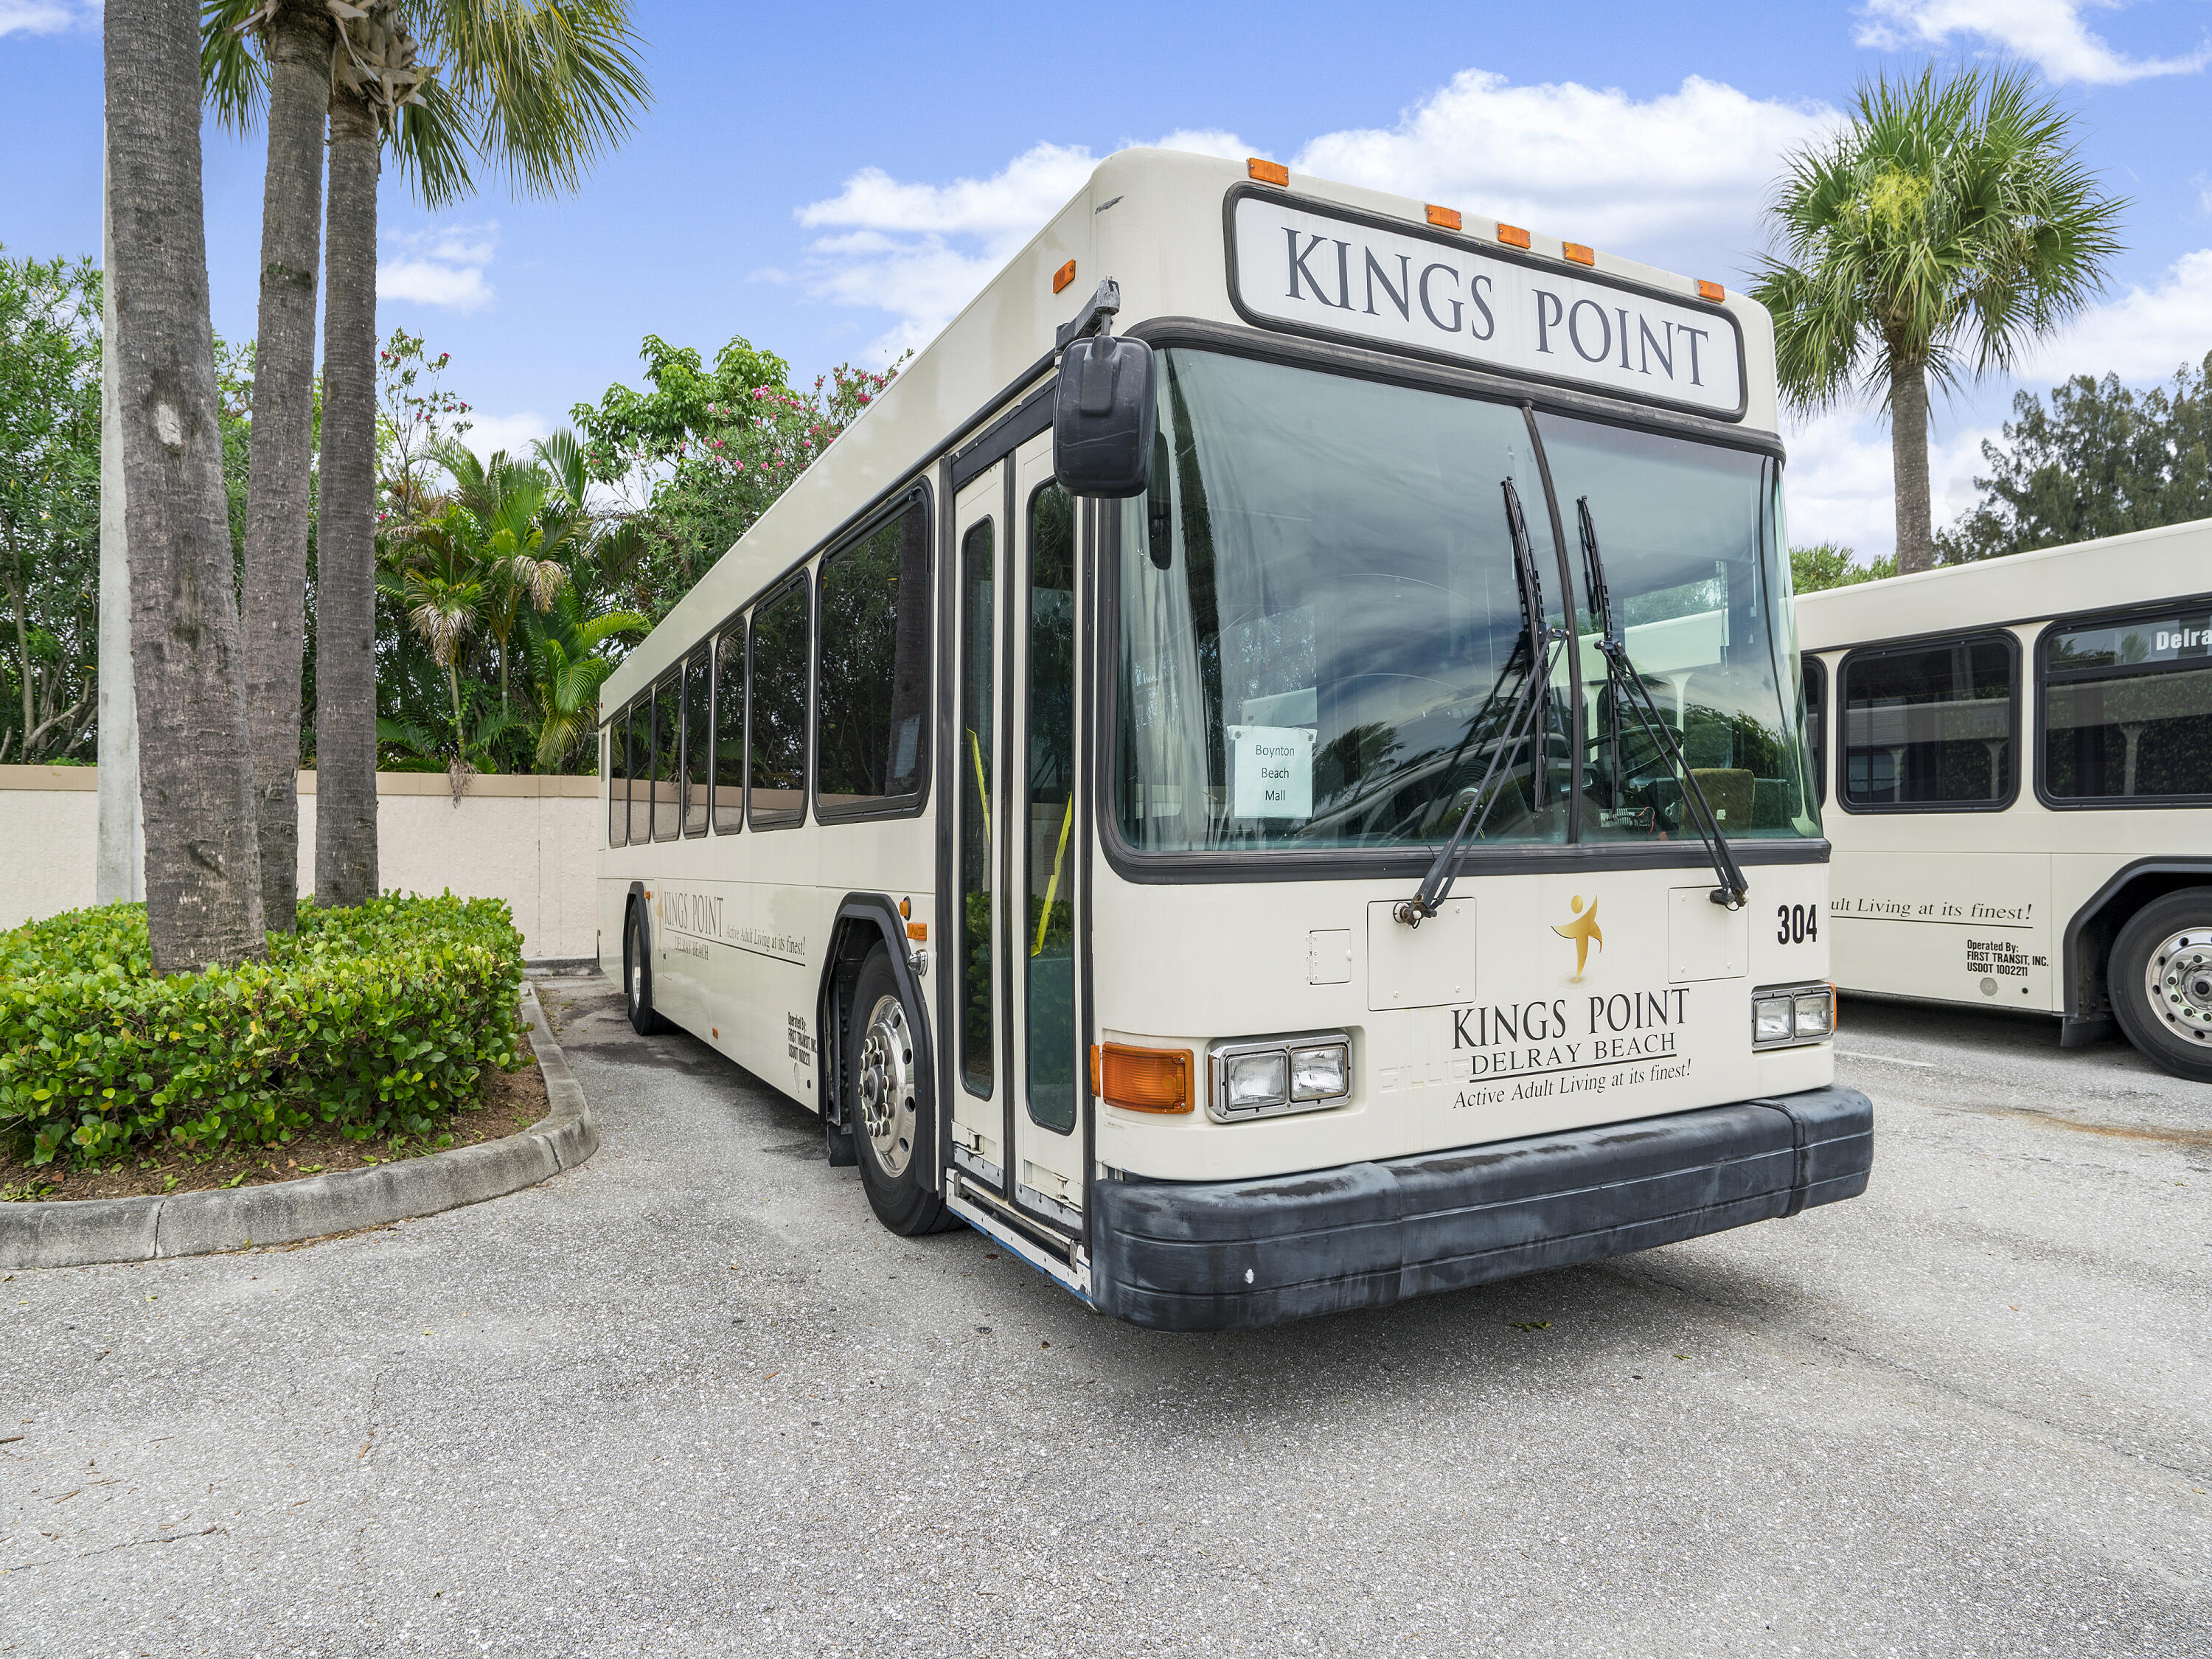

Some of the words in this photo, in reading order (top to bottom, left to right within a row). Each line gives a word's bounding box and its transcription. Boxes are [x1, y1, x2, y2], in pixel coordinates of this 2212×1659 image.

[1281, 226, 1495, 341] KINGS
[1532, 288, 1709, 386] POINT
[2156, 627, 2212, 650] Delra
[1256, 745, 1295, 758] Boynton
[1262, 768, 1289, 778] Beach
[1265, 790, 1285, 801] Mall
[664, 891, 688, 929] KINGS
[692, 894, 723, 937] POINT
[1831, 897, 1851, 911] ult
[1857, 899, 1911, 917] Living
[1919, 903, 1935, 915] at
[1941, 902, 1962, 917] its
[1971, 902, 2032, 919] finest!
[1778, 904, 1817, 945] 304
[675, 936, 692, 954] DELRAY
[692, 942, 709, 960] BEACH
[726, 923, 740, 939] Active
[740, 927, 753, 942] Adult
[754, 928, 770, 952] Living
[771, 935, 777, 949] at
[786, 936, 805, 956] finest!
[1967, 939, 2003, 952] Operated
[2006, 942, 2019, 953] By:
[1967, 951, 1990, 961] FIRST
[1992, 953, 2030, 965] TRANSIT,
[2032, 956, 2049, 967] INC.
[1967, 962, 1994, 973] USDOT
[1996, 964, 2028, 976] 1002211
[1450, 999, 1566, 1049] KINGS
[1588, 988, 1690, 1034] POINT
[1470, 1043, 1582, 1075] DELRAY
[1593, 1032, 1676, 1060] BEACH
[1453, 1088, 1505, 1109] Active
[1512, 1080, 1554, 1101] Adult
[1559, 1075, 1605, 1094] Living
[1611, 1070, 1624, 1086] at
[1630, 1068, 1644, 1085] its
[1649, 1058, 1691, 1081] finest!
